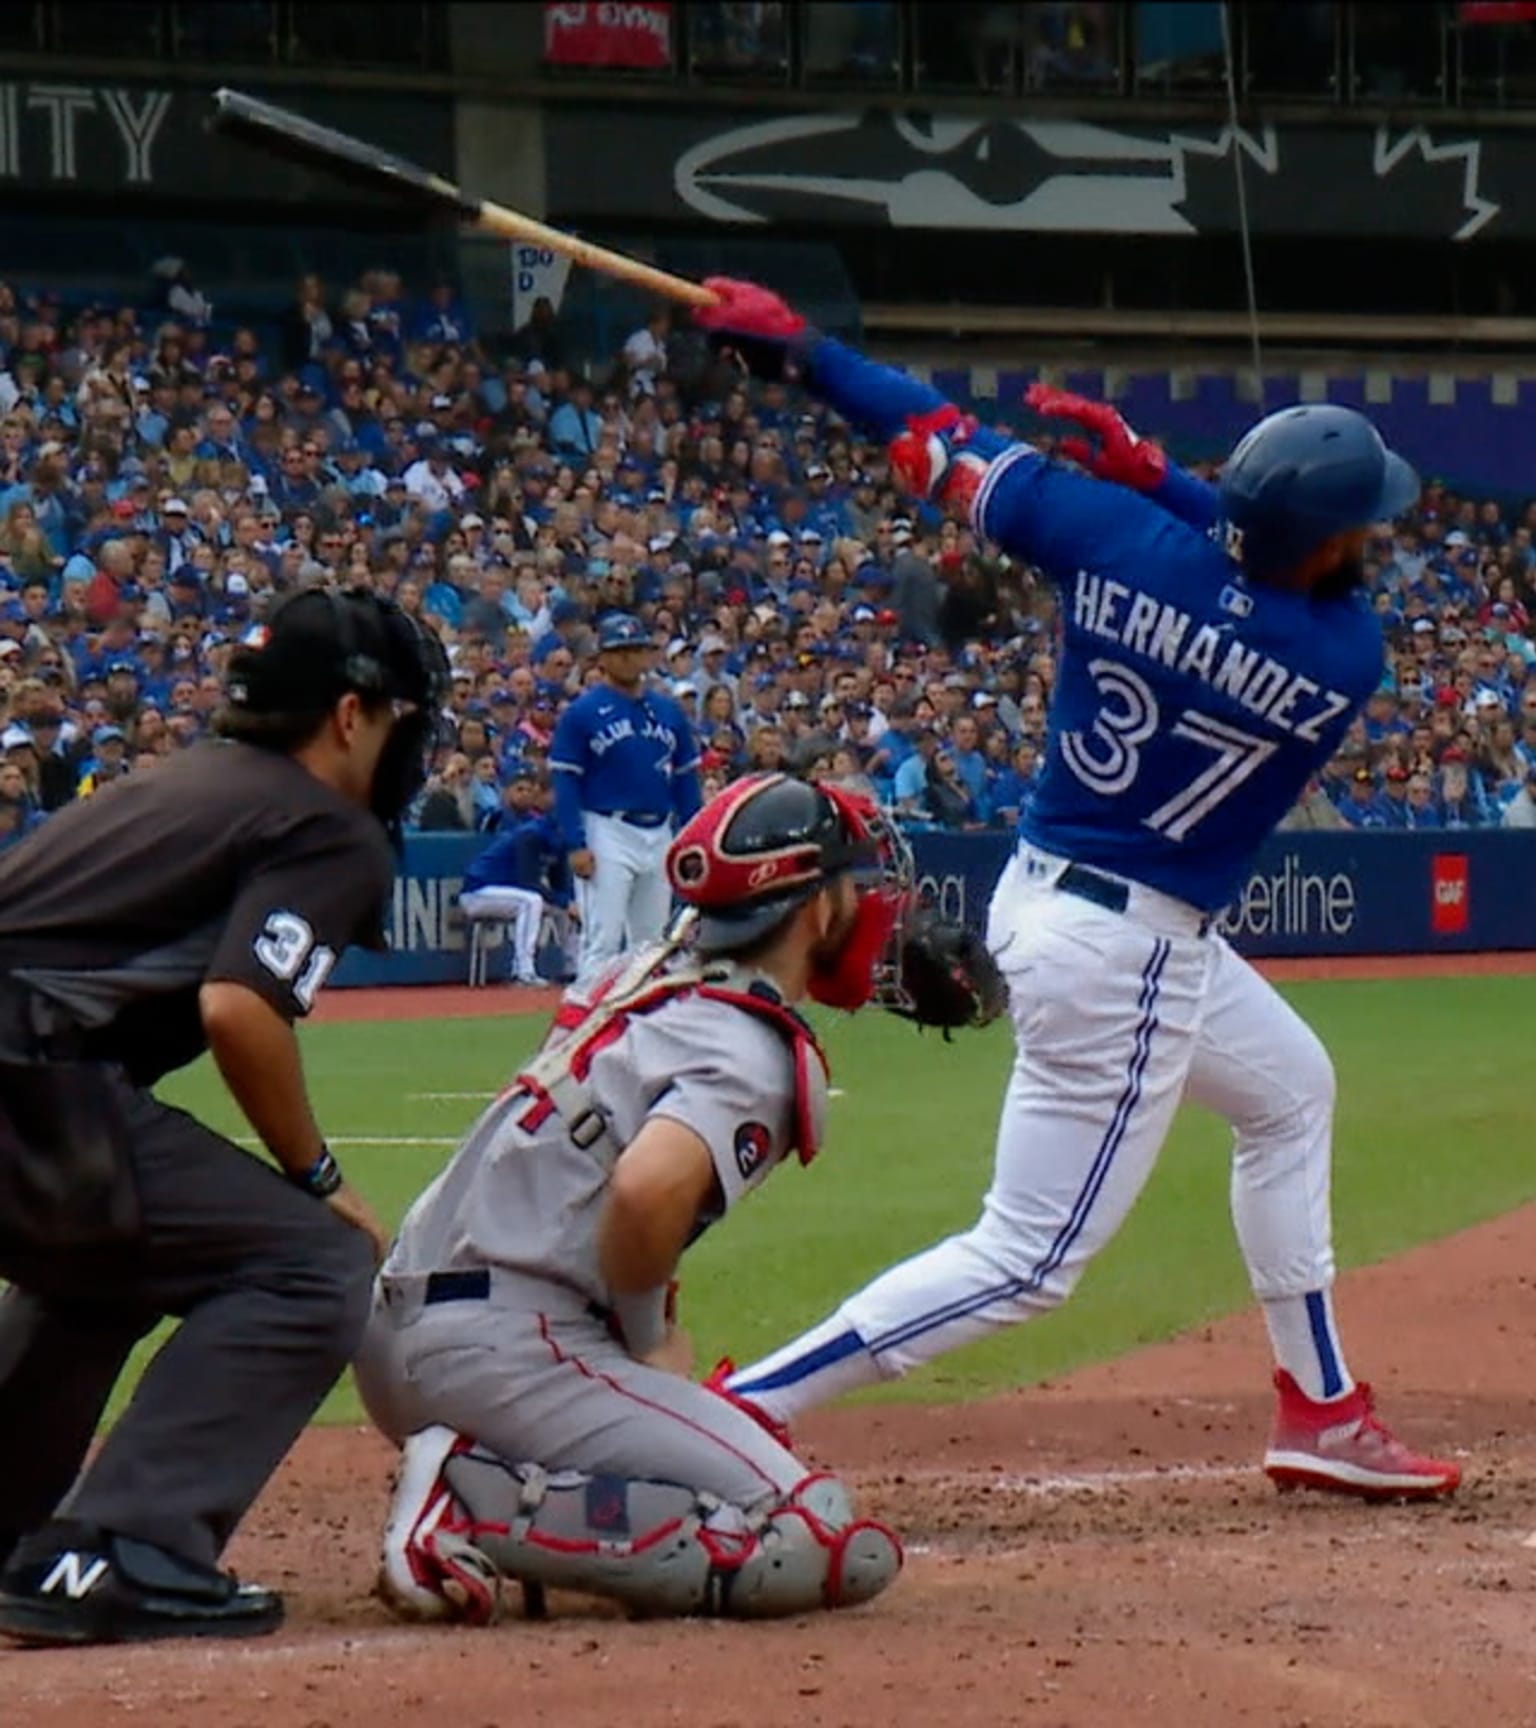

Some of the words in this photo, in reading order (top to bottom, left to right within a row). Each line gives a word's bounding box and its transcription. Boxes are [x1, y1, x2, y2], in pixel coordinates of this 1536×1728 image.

[589, 718, 636, 757] BLUE
[1060, 657, 1280, 843] 37
[253, 911, 338, 1012] 31
[40, 1551, 109, 1598] N
